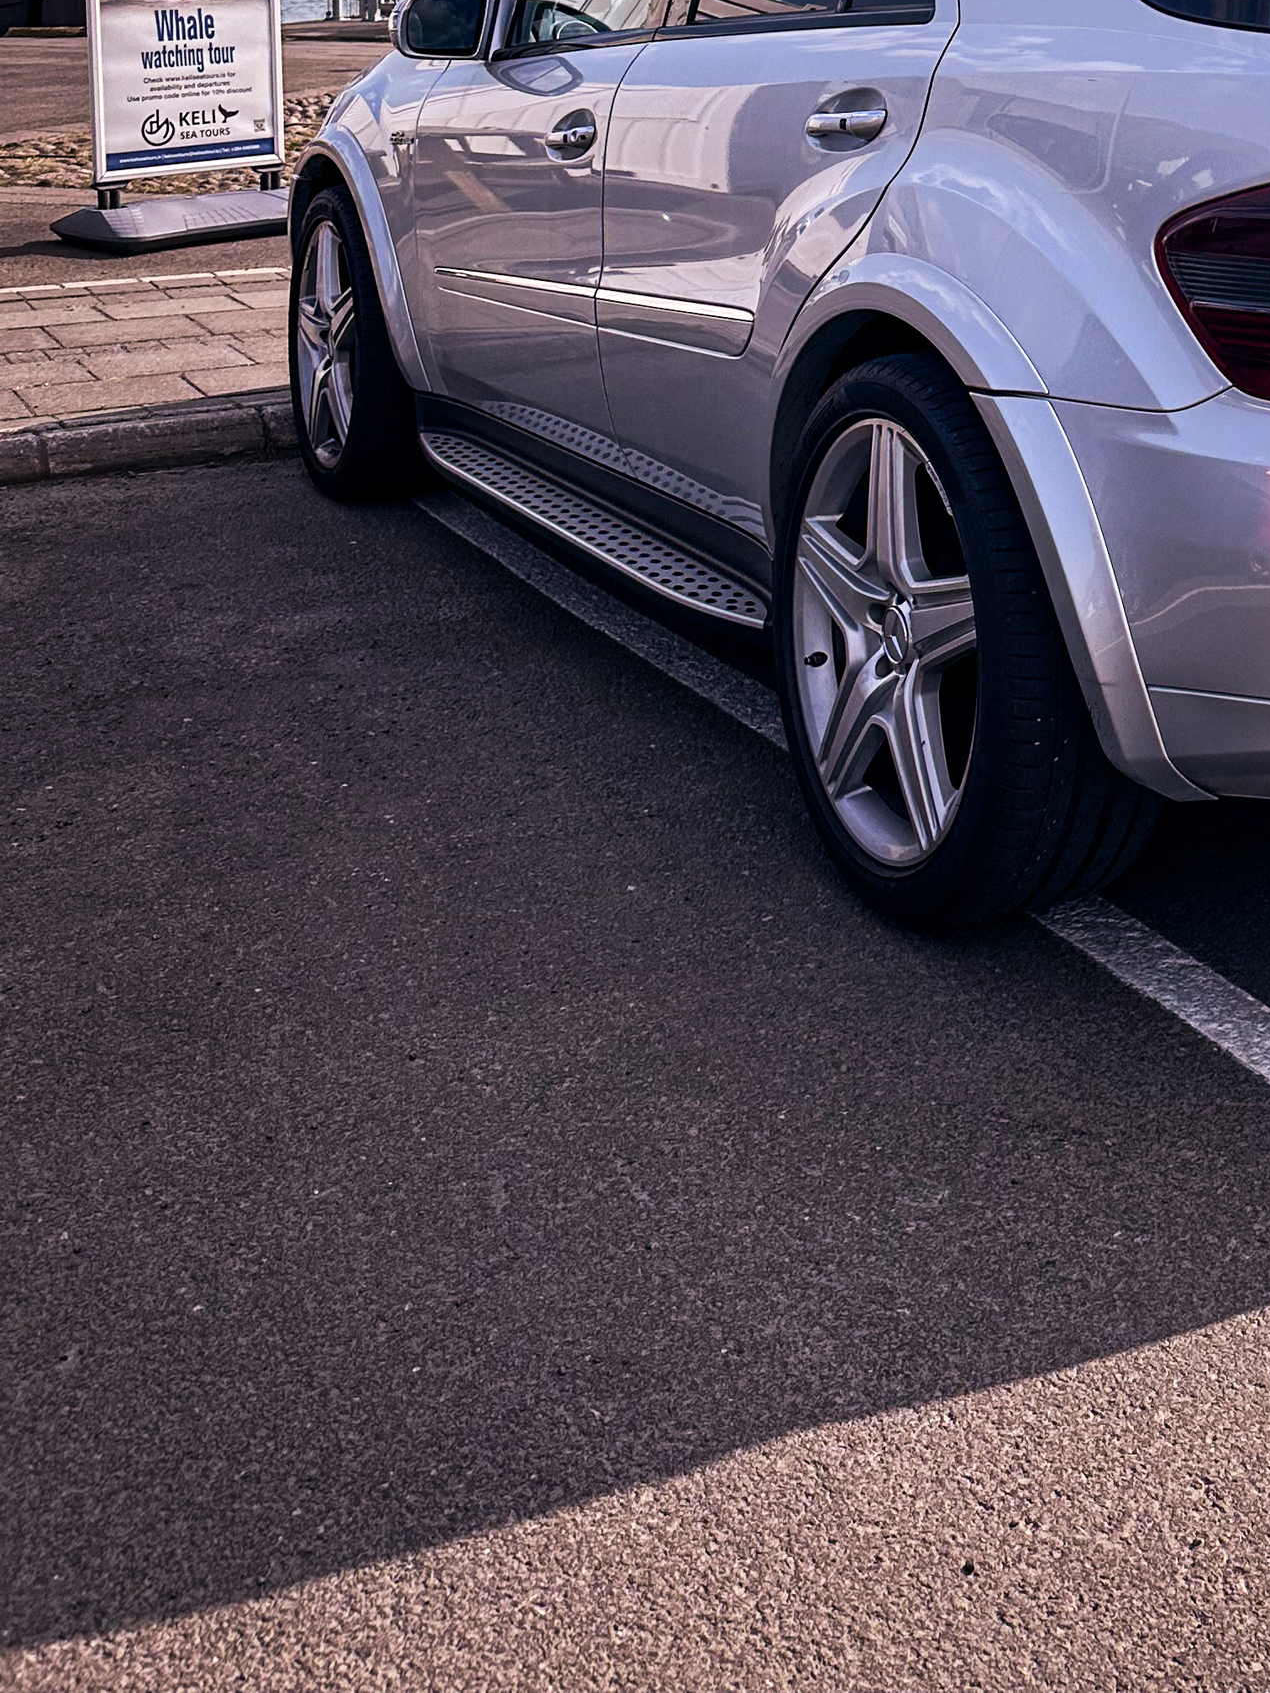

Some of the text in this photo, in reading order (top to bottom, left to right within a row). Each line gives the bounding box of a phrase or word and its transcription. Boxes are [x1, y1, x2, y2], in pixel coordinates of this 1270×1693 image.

[154, 8, 215, 42] Whale
[141, 42, 235, 72] watching tour
[143, 76, 163, 84] Check
[149, 84, 182, 93] availability
[197, 80, 230, 89] departures
[141, 95, 163, 103] promo
[181, 90, 200, 98] online
[226, 86, 253, 94] discount
[179, 109, 216, 127] KELI
[180, 127, 231, 140] SEA TOURS
